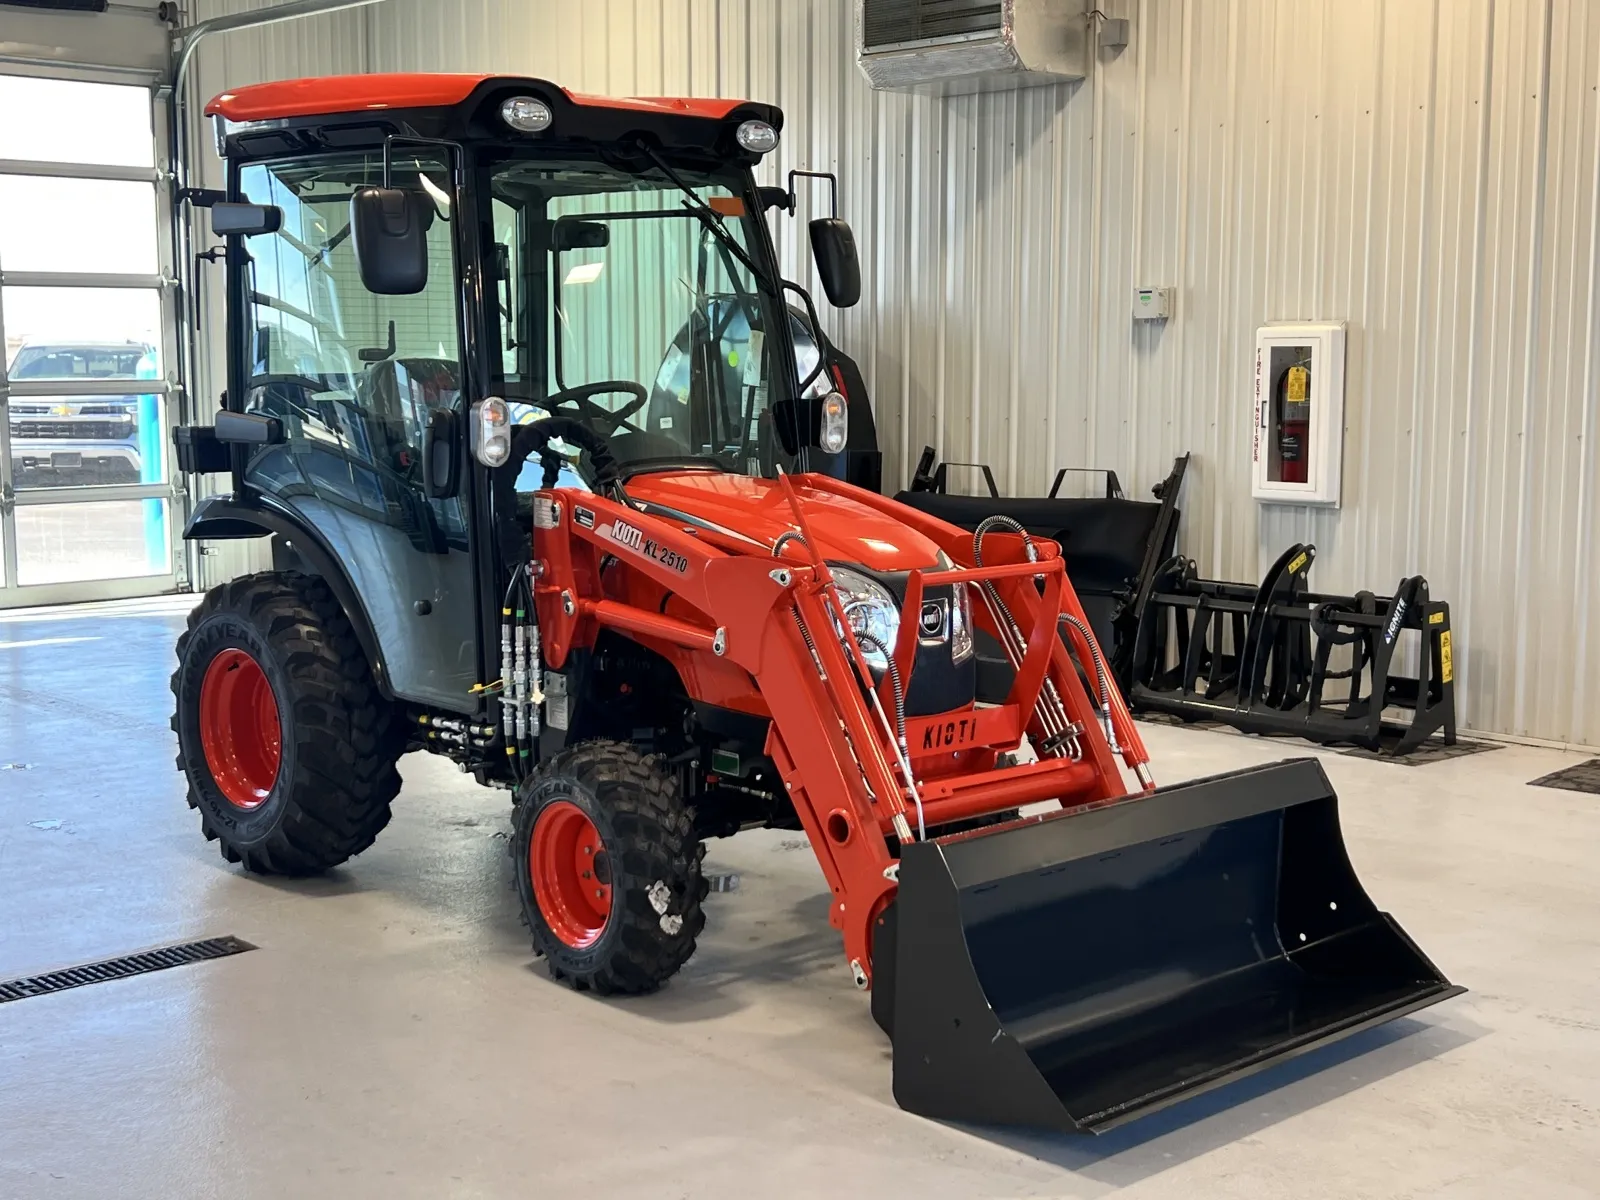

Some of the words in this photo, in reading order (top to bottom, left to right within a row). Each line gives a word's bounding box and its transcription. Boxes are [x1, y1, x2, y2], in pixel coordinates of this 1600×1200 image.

[611, 519, 643, 550] KIOTI
[643, 540, 657, 558] KL
[660, 546, 688, 573] 2510
[1388, 597, 1406, 636] IGNITE
[922, 718, 977, 750] KIOTI
